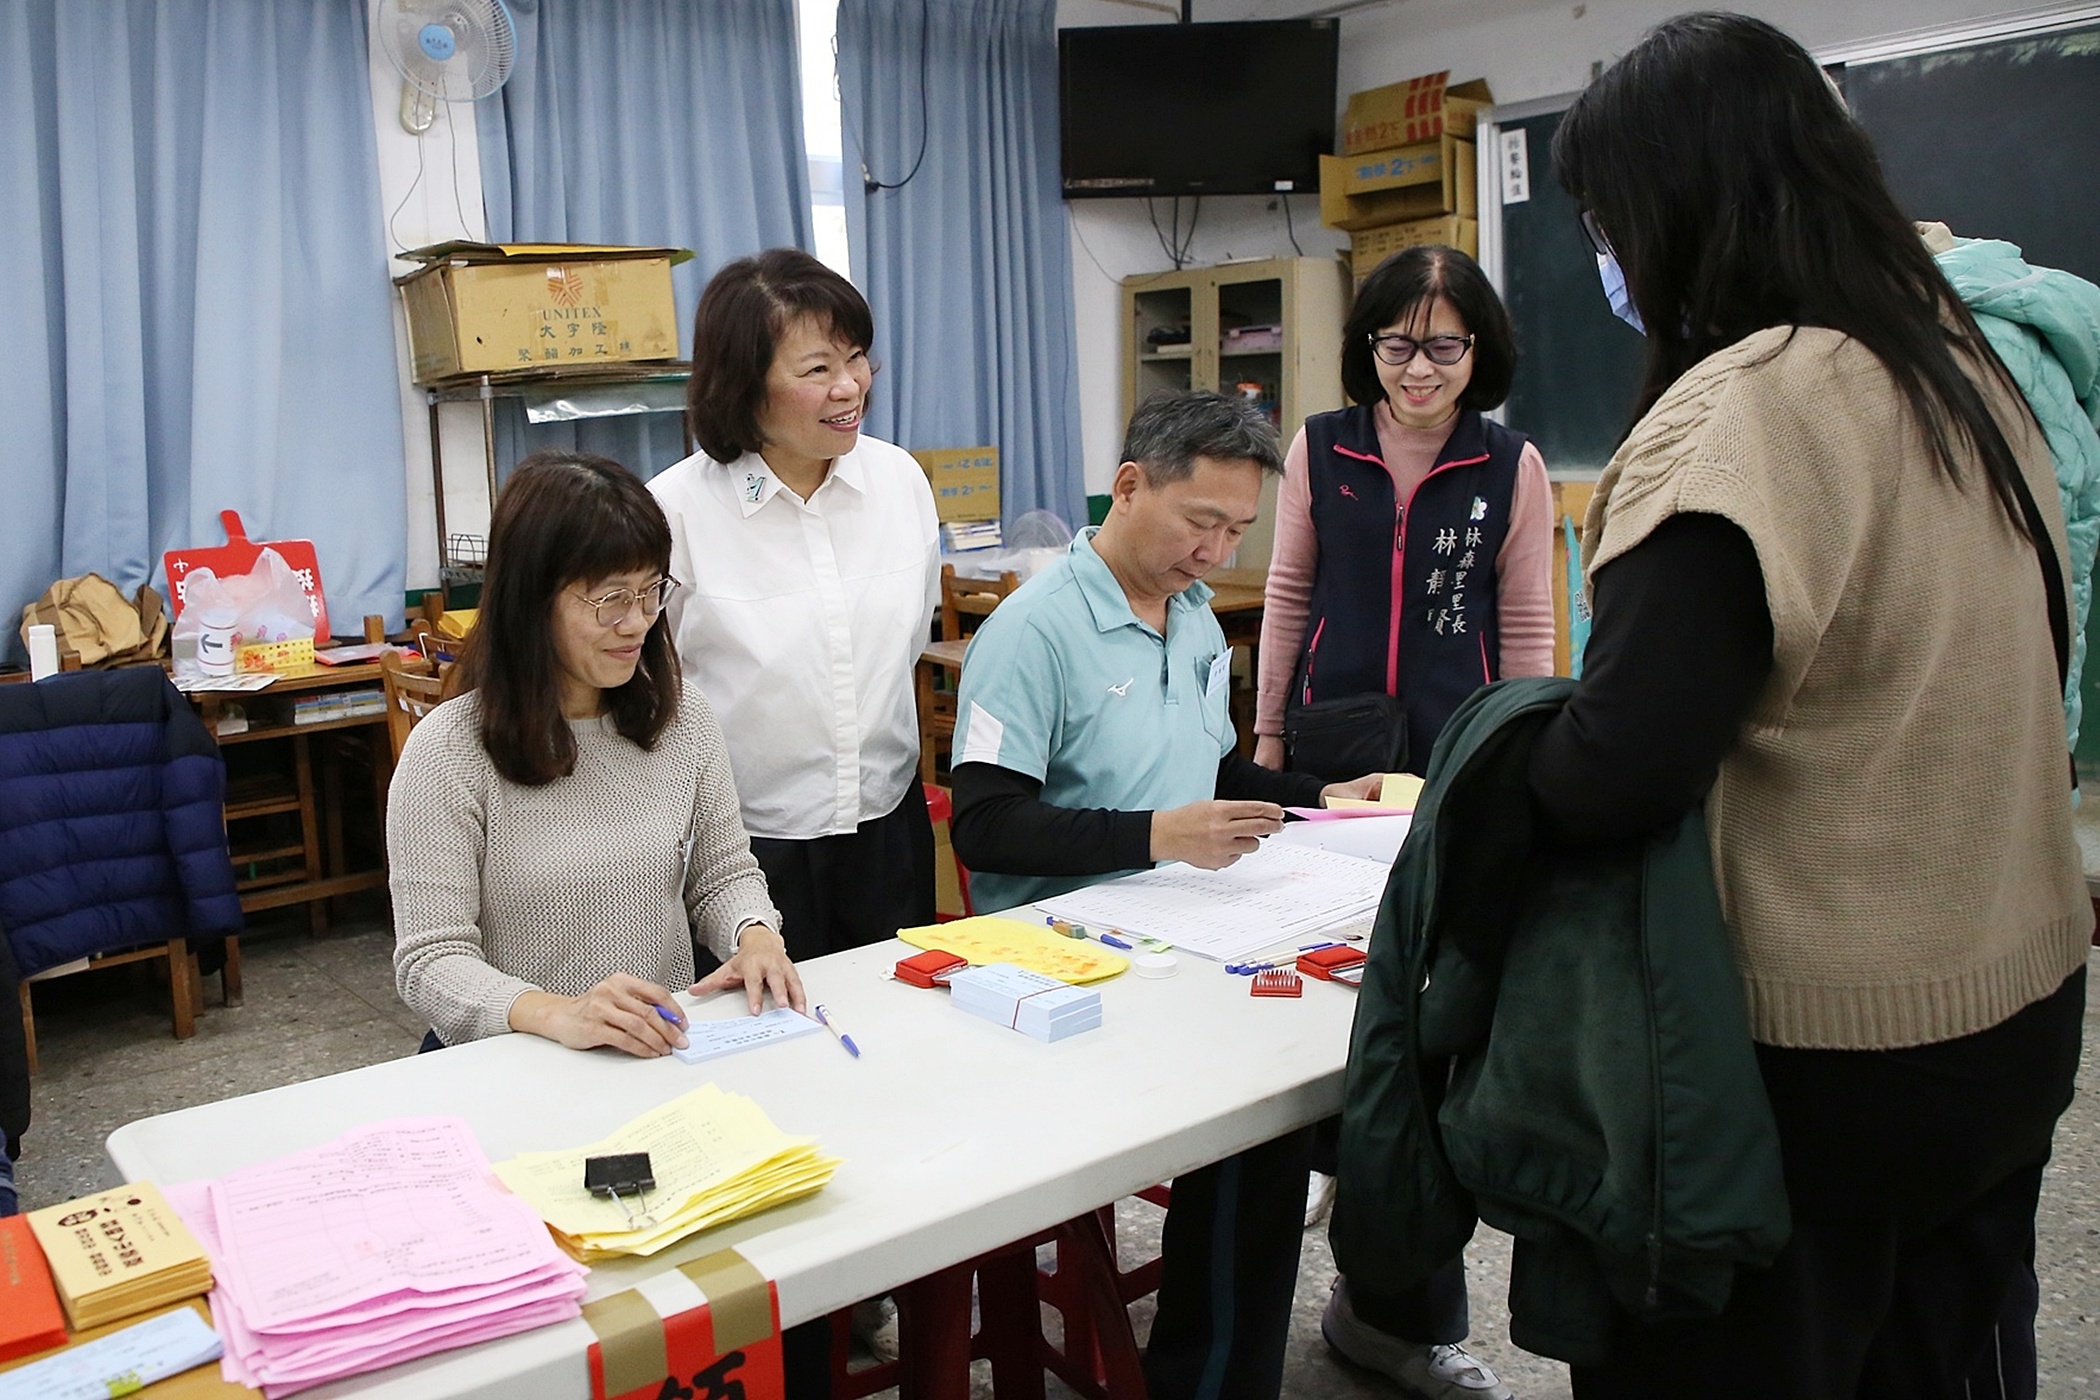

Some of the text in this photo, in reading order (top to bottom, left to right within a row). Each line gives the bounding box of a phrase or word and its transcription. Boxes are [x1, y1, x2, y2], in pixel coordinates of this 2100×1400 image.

[543, 306, 602, 321] UNITEX
[1451, 526, 1483, 635] 林森里里長
